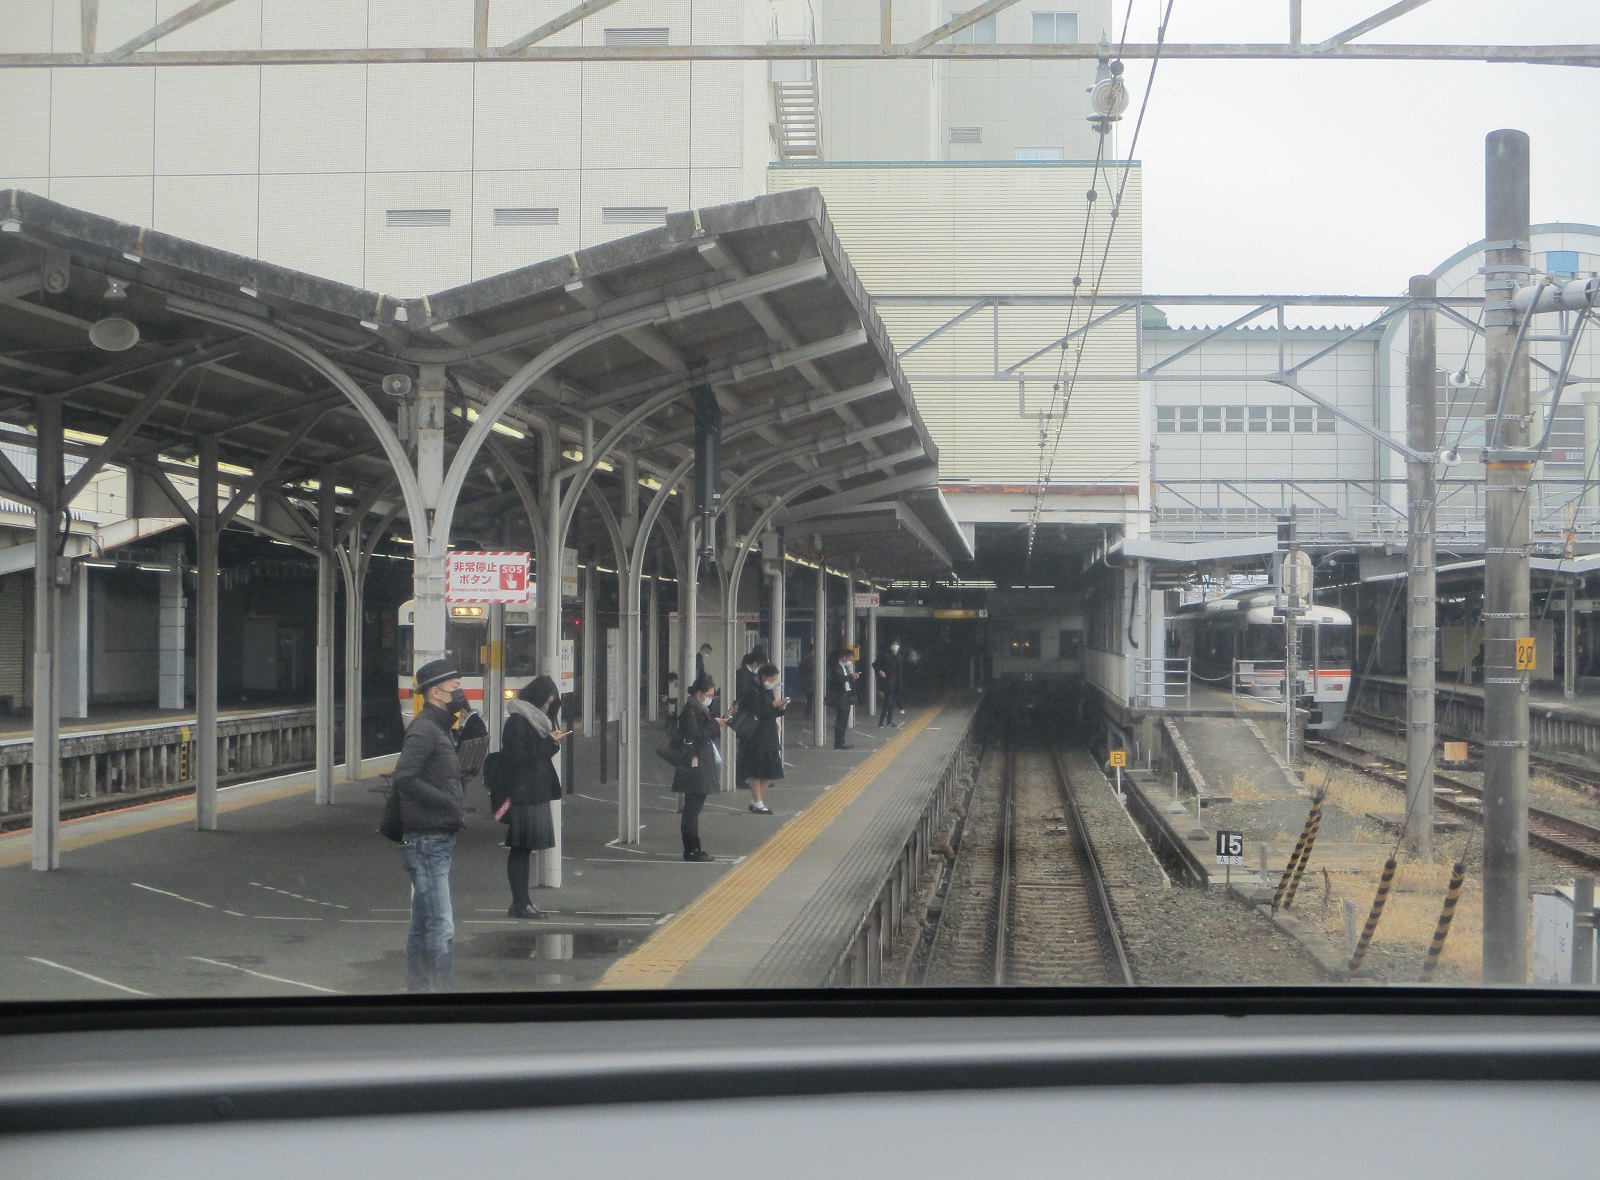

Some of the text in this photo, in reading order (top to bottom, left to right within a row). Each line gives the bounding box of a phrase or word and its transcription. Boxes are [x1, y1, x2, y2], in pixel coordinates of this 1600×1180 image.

[453, 561, 497, 573] 非常停止
[502, 565, 523, 574] SOS
[459, 574, 492, 585] ボタン
[1114, 753, 1123, 764] B
[1221, 834, 1242, 855] 15
